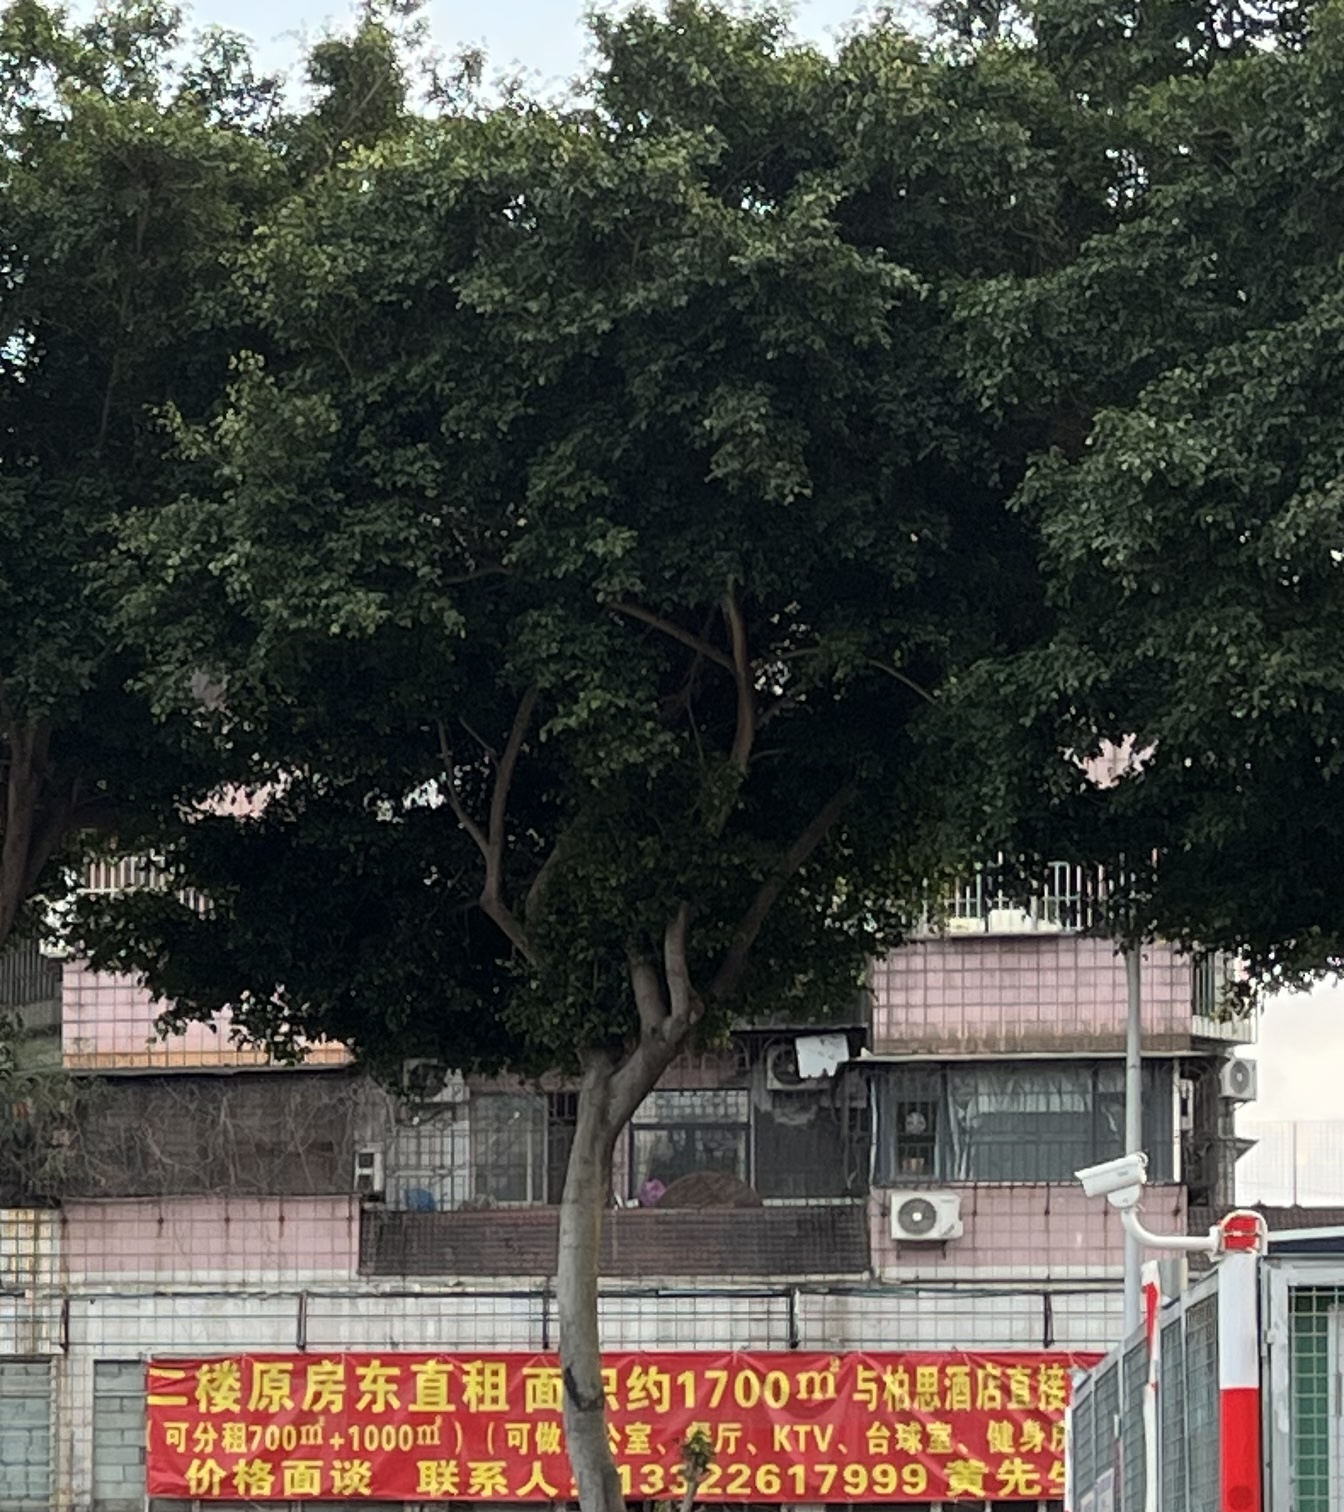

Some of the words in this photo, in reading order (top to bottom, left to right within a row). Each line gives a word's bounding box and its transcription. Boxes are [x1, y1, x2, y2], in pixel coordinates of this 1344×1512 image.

[147, 1360, 510, 1414] 二楼原房东直租
[186, 1458, 372, 1496] 价格面谈
